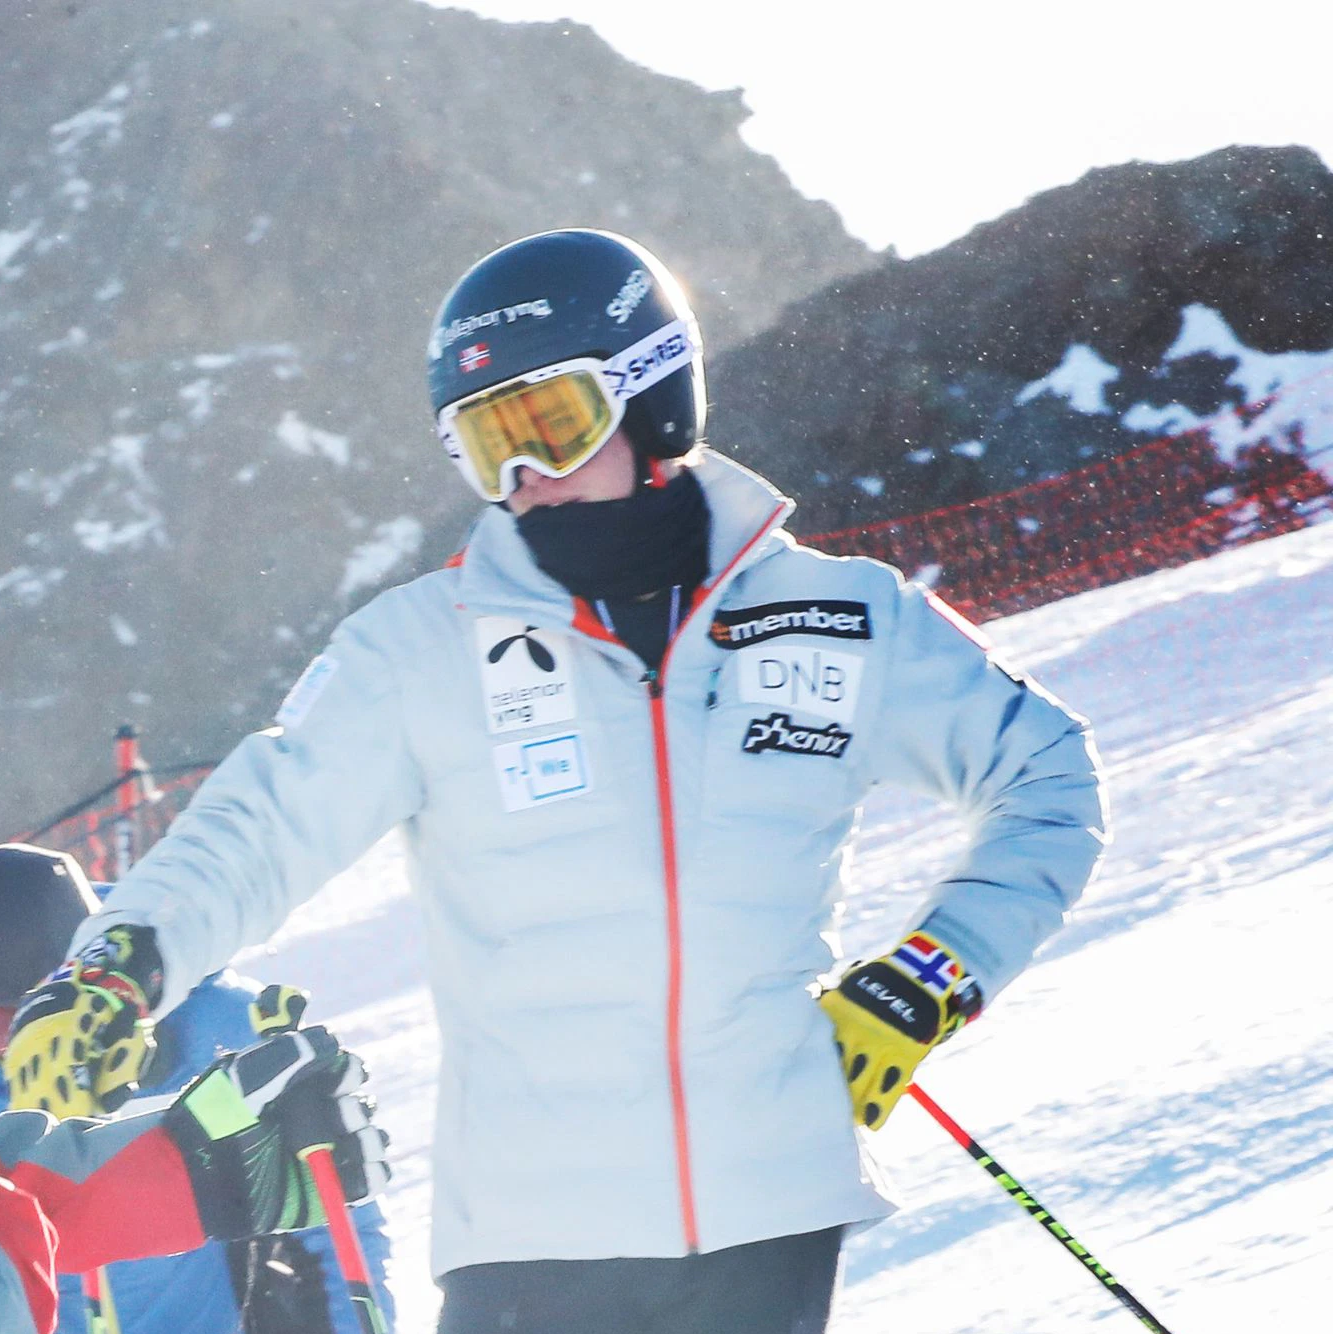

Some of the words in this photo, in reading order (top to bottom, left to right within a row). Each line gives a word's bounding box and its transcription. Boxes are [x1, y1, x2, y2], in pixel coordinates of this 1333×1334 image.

[759, 651, 846, 703] DNB
[744, 716, 848, 753] phenix
[856, 975, 917, 1024] LEVEL
